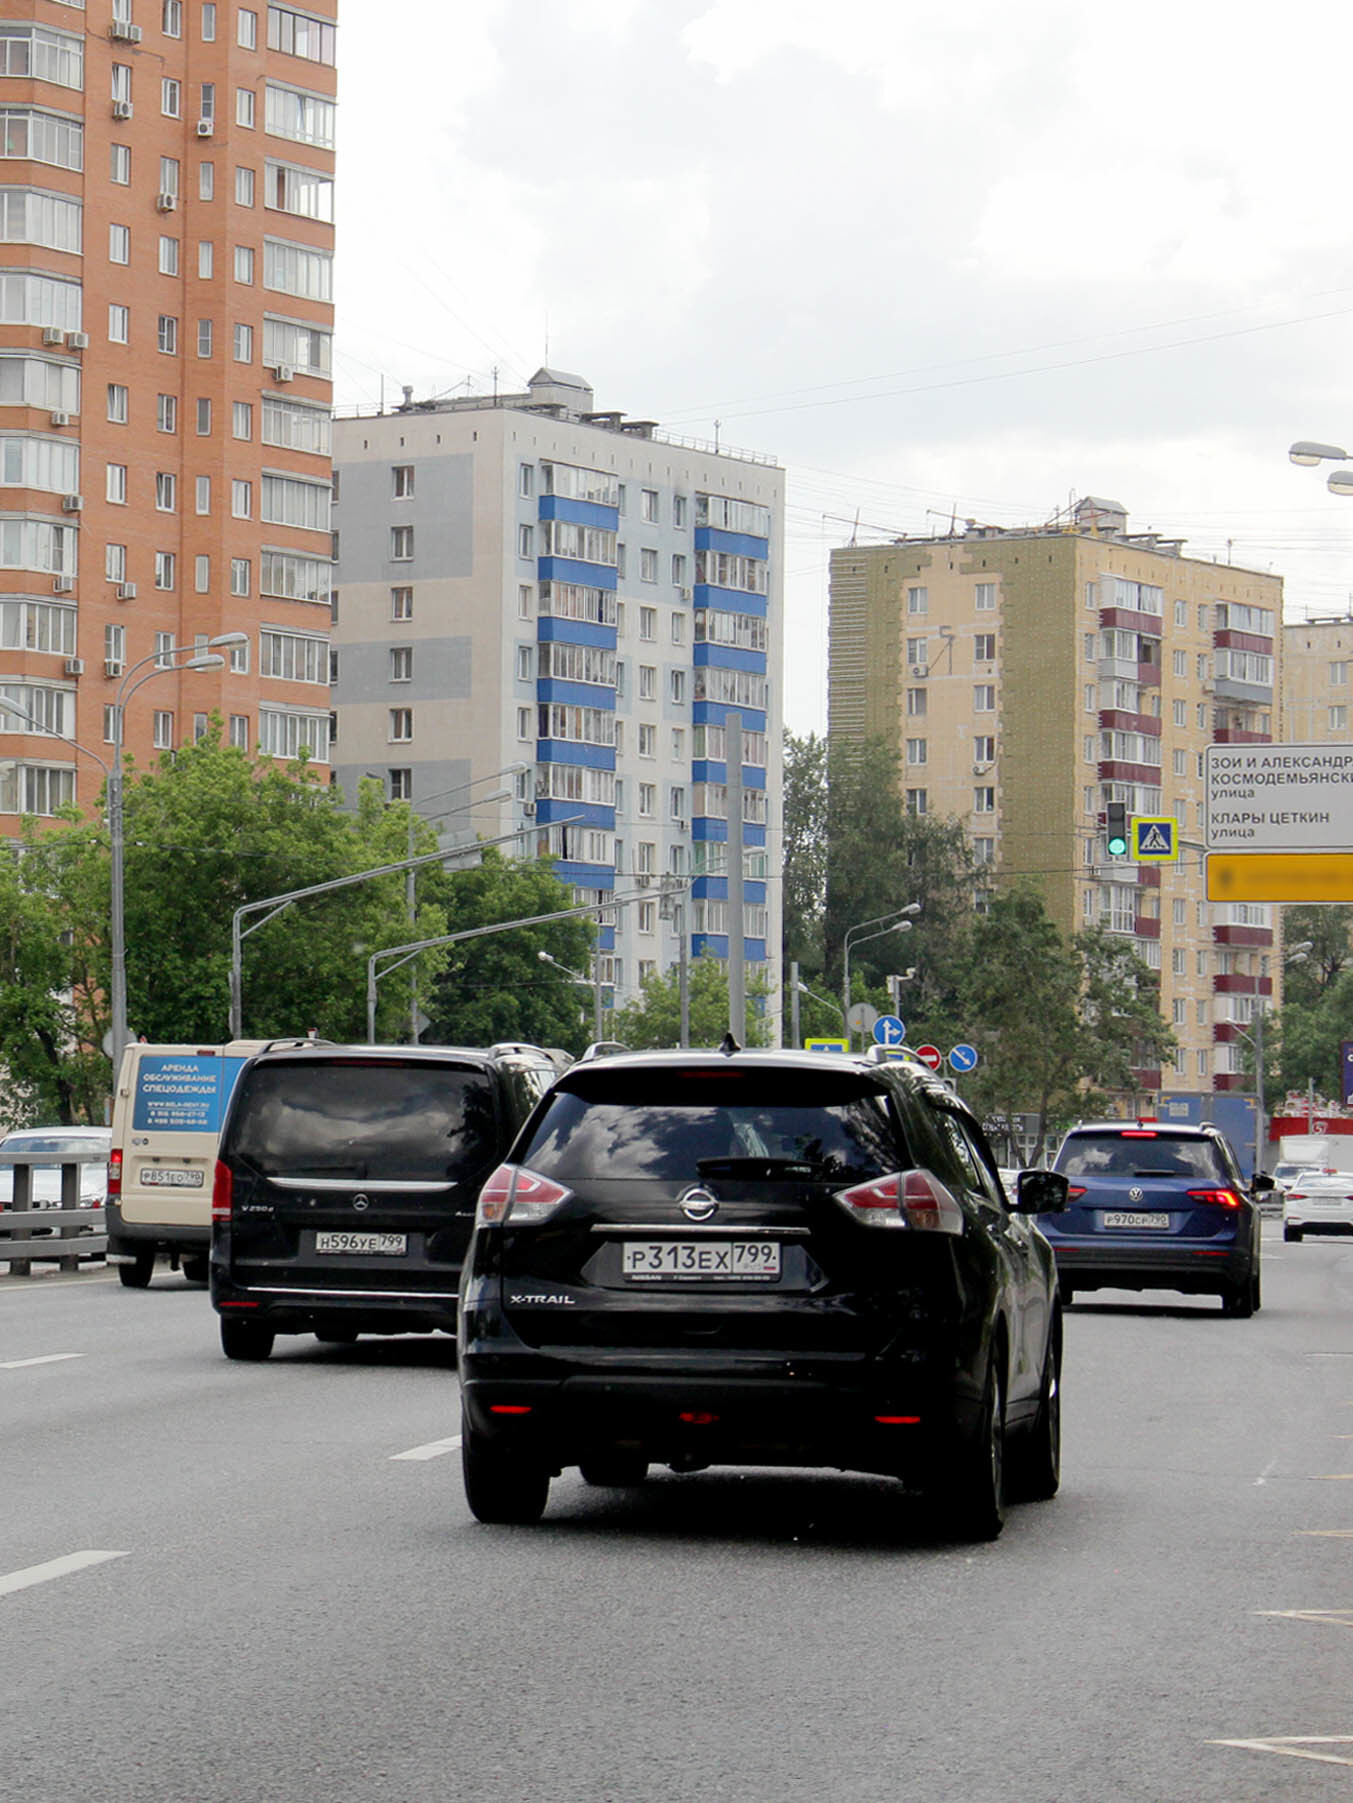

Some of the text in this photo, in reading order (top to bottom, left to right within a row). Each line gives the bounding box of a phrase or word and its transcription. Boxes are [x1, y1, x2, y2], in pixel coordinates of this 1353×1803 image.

[1211, 757, 1242, 769] ЗОИ
[1247, 757, 1256, 768] И
[1211, 789, 1255, 800] улица
[1211, 812, 1330, 826] КЛАРЫ ЦЕТКИН
[1211, 828, 1255, 840] улица
[161, 1064, 199, 1072] АРЕНДА
[143, 1073, 217, 1083] ОБСЛУЖИВАНИЕ
[142, 1084, 216, 1095] СПЕЦОДЕЖДЫ
[321, 1235, 376, 1250] Н596УЕ
[632, 1245, 772, 1270] Р313ЕХ 799
[510, 1295, 576, 1304] X-TRAIL
